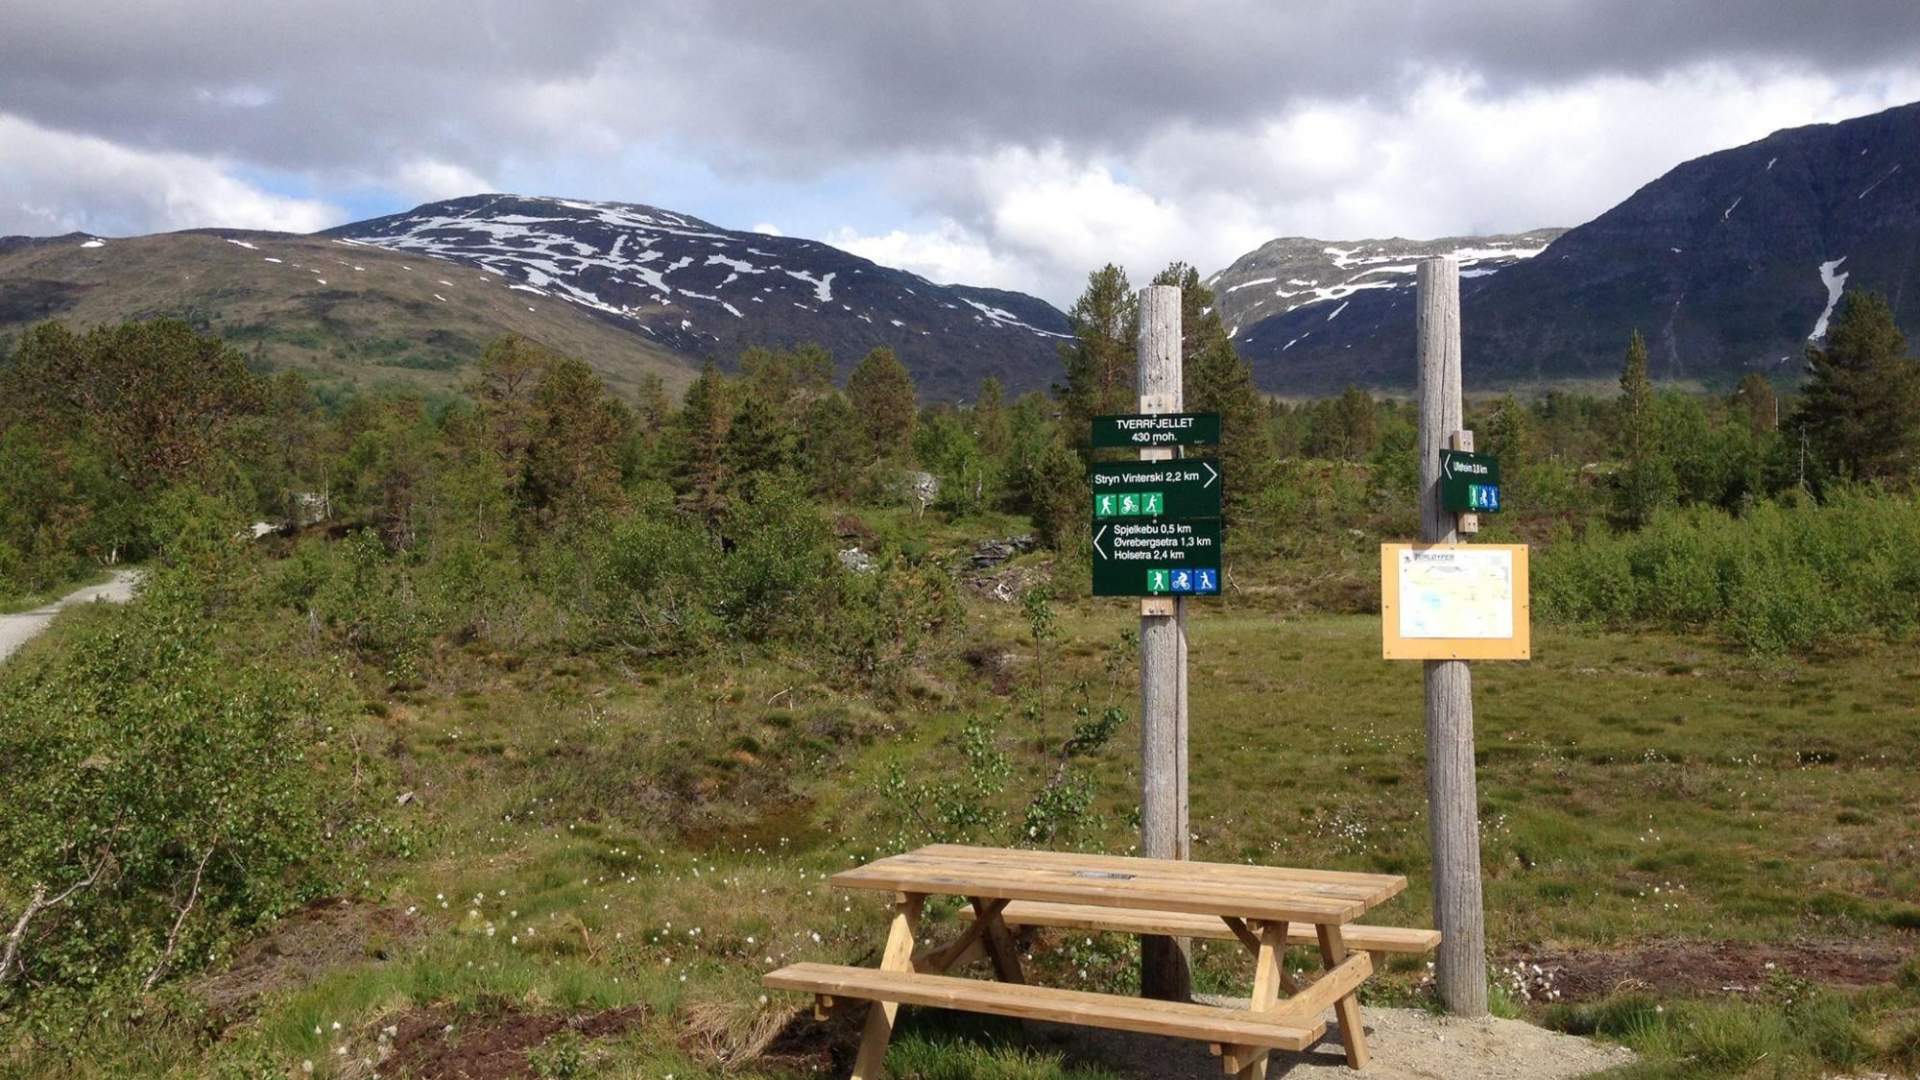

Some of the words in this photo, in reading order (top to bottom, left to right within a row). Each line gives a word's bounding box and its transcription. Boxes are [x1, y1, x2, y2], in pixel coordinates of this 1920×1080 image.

[1116, 418, 1194, 429] TVERRFJELLET
[1132, 432, 1150, 442] 430
[1153, 431, 1177, 441] moh.
[1095, 474, 1120, 486] Stryn
[1122, 471, 1164, 483] Vinterski
[1165, 471, 1182, 482] 2,2
[1183, 470, 1200, 481] km
[1114, 524, 1158, 536] Spjelkebu
[1160, 524, 1175, 535] 0,5
[1176, 523, 1192, 534] km
[1114, 537, 1178, 549] Øvrebergsetra
[1180, 537, 1195, 548] 1,3
[1196, 536, 1212, 547] km
[1114, 550, 1152, 560] Holsetra
[1153, 550, 1168, 561] 2,4
[1169, 550, 1185, 560] km
